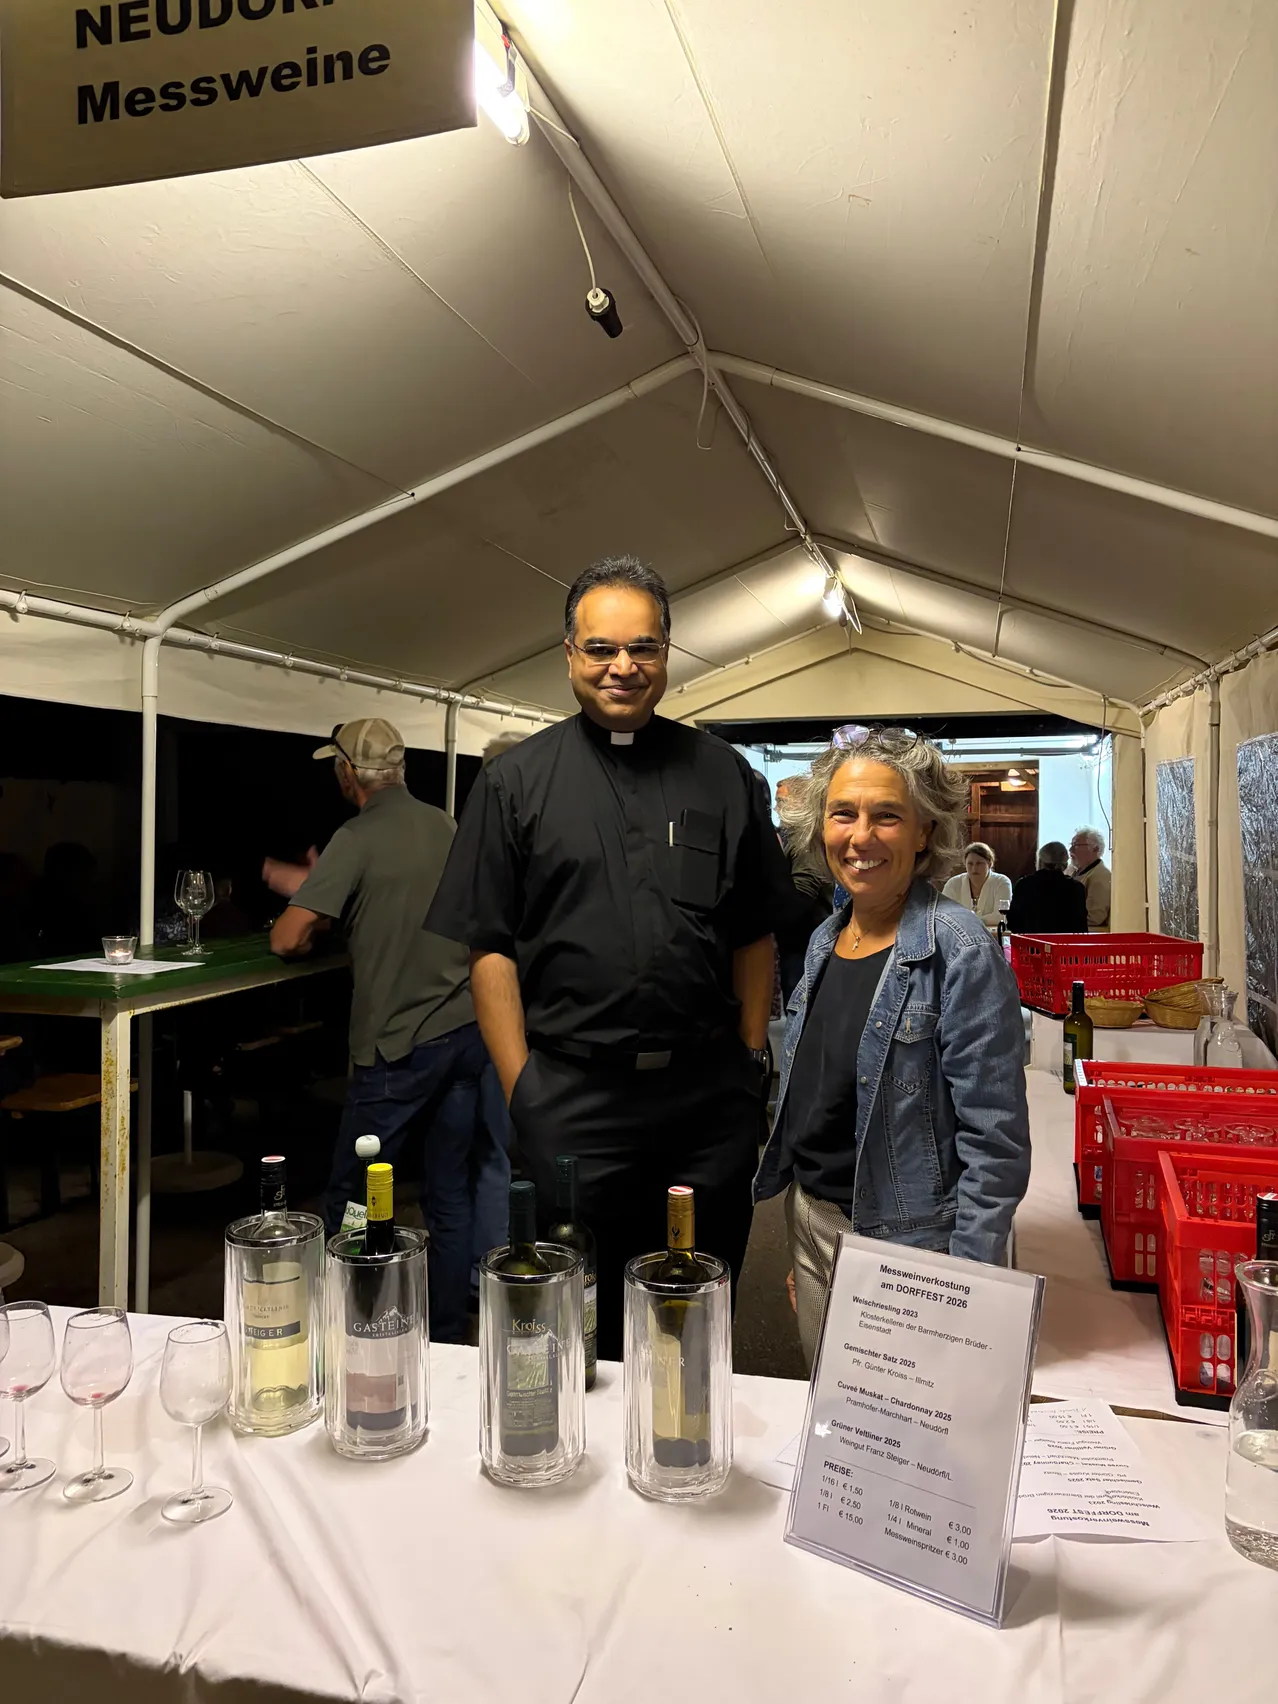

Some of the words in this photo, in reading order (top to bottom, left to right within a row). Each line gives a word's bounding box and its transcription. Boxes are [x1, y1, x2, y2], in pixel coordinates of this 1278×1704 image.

[76, 43, 391, 125] Messweine
[879, 1264, 971, 1295] Messweinverkostung
[880, 1281, 894, 1291] am
[895, 1283, 945, 1303] DORFFEST
[946, 1296, 968, 1309] 2026
[512, 1318, 546, 1334] Kroiss
[858, 1320, 892, 1336] Eisenstadt
[902, 1308, 919, 1319] 2023
[860, 1310, 905, 1329] Klosterkellerei
[905, 1322, 917, 1332] der
[917, 1325, 964, 1344] Barmherzigen
[964, 1337, 988, 1351] Brüder
[843, 1342, 882, 1359] Gemischter
[882, 1353, 898, 1365] Satz
[899, 1358, 916, 1369] 2025
[852, 1358, 863, 1367] Pfr.
[864, 1361, 886, 1374] Günter
[887, 1368, 908, 1381] Kroiss
[915, 1376, 935, 1389] Illmitz
[845, 1396, 913, 1424] Pramhofer-Marchhart
[919, 1419, 949, 1436] Neudörfl
[859, 1387, 884, 1401] Muskat
[890, 1396, 934, 1417] Chardonnay
[934, 1410, 952, 1422] 2025
[831, 1419, 854, 1433] Grüner
[854, 1427, 883, 1442] Veltliner
[884, 1437, 901, 1449] 2025
[839, 1436, 865, 1452] Weingut
[865, 1445, 885, 1458] Franz
[886, 1451, 910, 1467] Steiger
[823, 1460, 854, 1478] PREISE:
[819, 1488, 829, 1498] 1/8
[840, 1496, 846, 1504] €
[846, 1499, 861, 1510] 2,50
[822, 1475, 836, 1486] 1/16
[842, 1482, 848, 1491] €
[849, 1485, 863, 1496] 1,50
[838, 1510, 844, 1518] €
[845, 1512, 864, 1525] 15,00
[889, 1499, 900, 1511] 1/8
[904, 1504, 932, 1522] Rotwein
[948, 1521, 954, 1530] €
[954, 1523, 972, 1536] 3,00
[1050, 1515, 1150, 1527] Messweinverkostung
[1072, 1508, 1124, 1516] DORFFEST
[884, 1526, 944, 1557] Messweinspritzer
[945, 1550, 951, 1558] €
[951, 1553, 968, 1566] 3,00
[887, 1513, 898, 1524] 1/4
[906, 1520, 932, 1537] Mineral
[946, 1535, 953, 1544] €
[954, 1538, 970, 1551] 1,00
